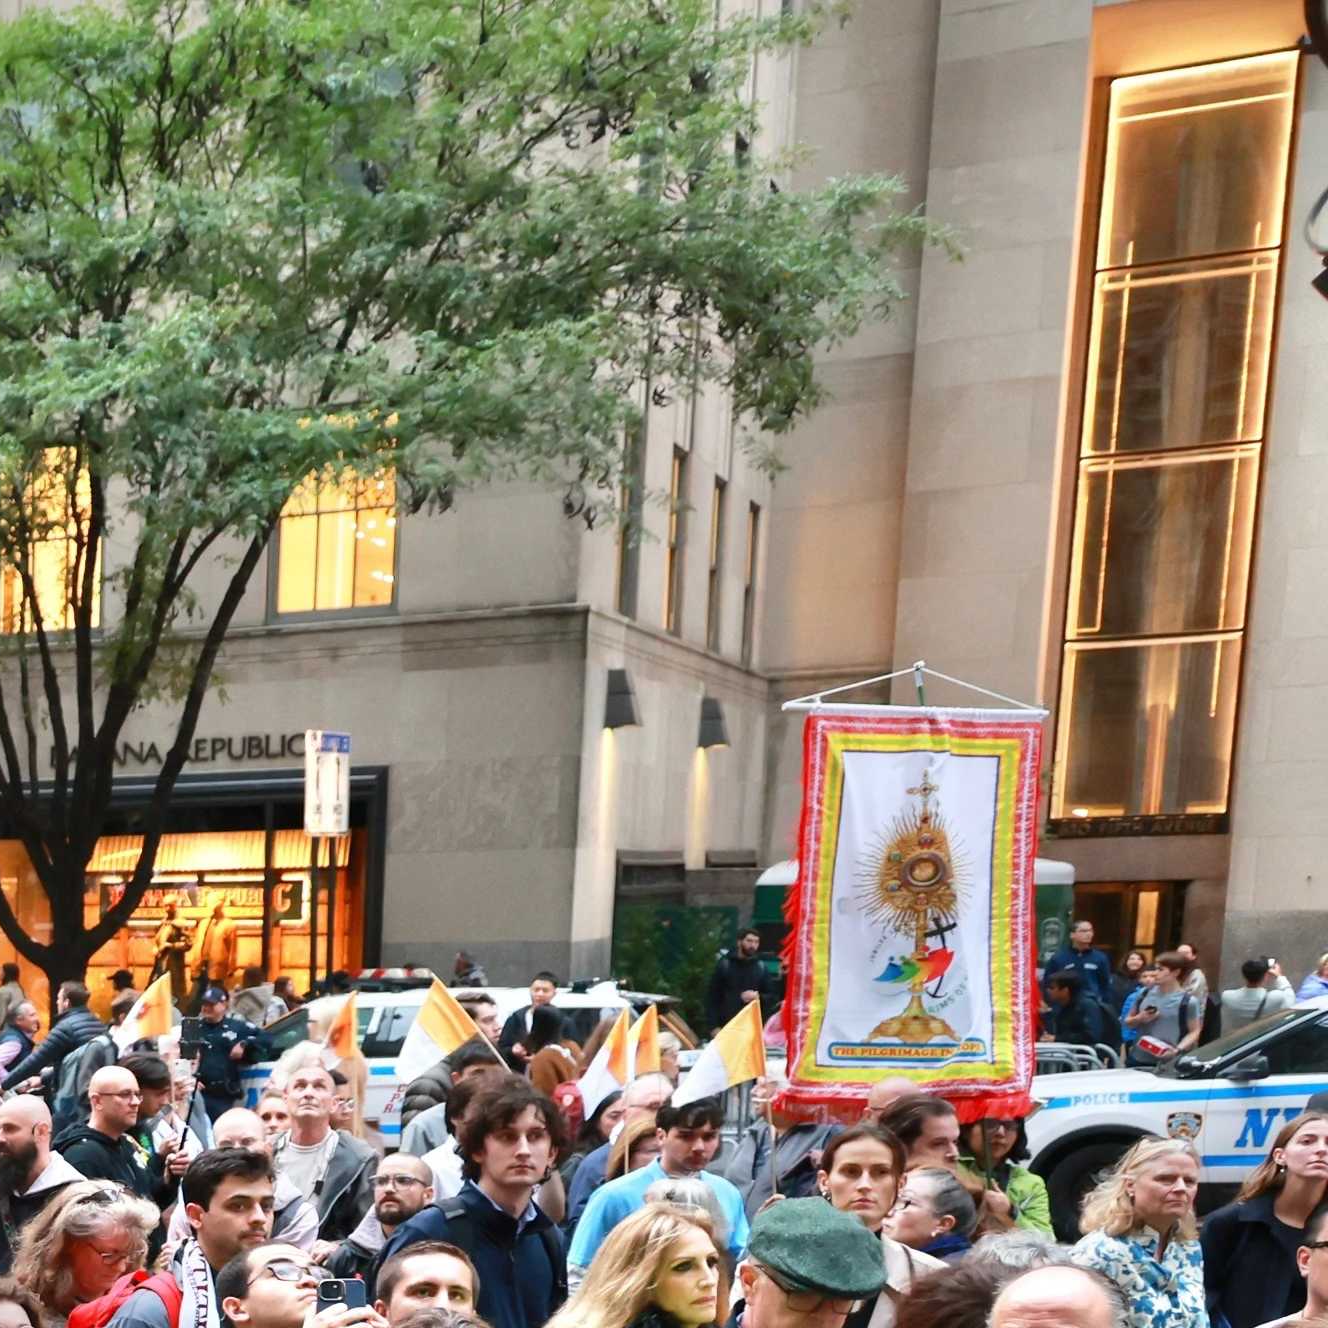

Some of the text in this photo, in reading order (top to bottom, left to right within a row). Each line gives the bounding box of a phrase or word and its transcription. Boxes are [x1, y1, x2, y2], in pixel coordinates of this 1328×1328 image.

[188, 733, 305, 762] EPUBLIC
[1073, 1092, 1127, 1107] POLICE
[1234, 1107, 1305, 1148] NY
